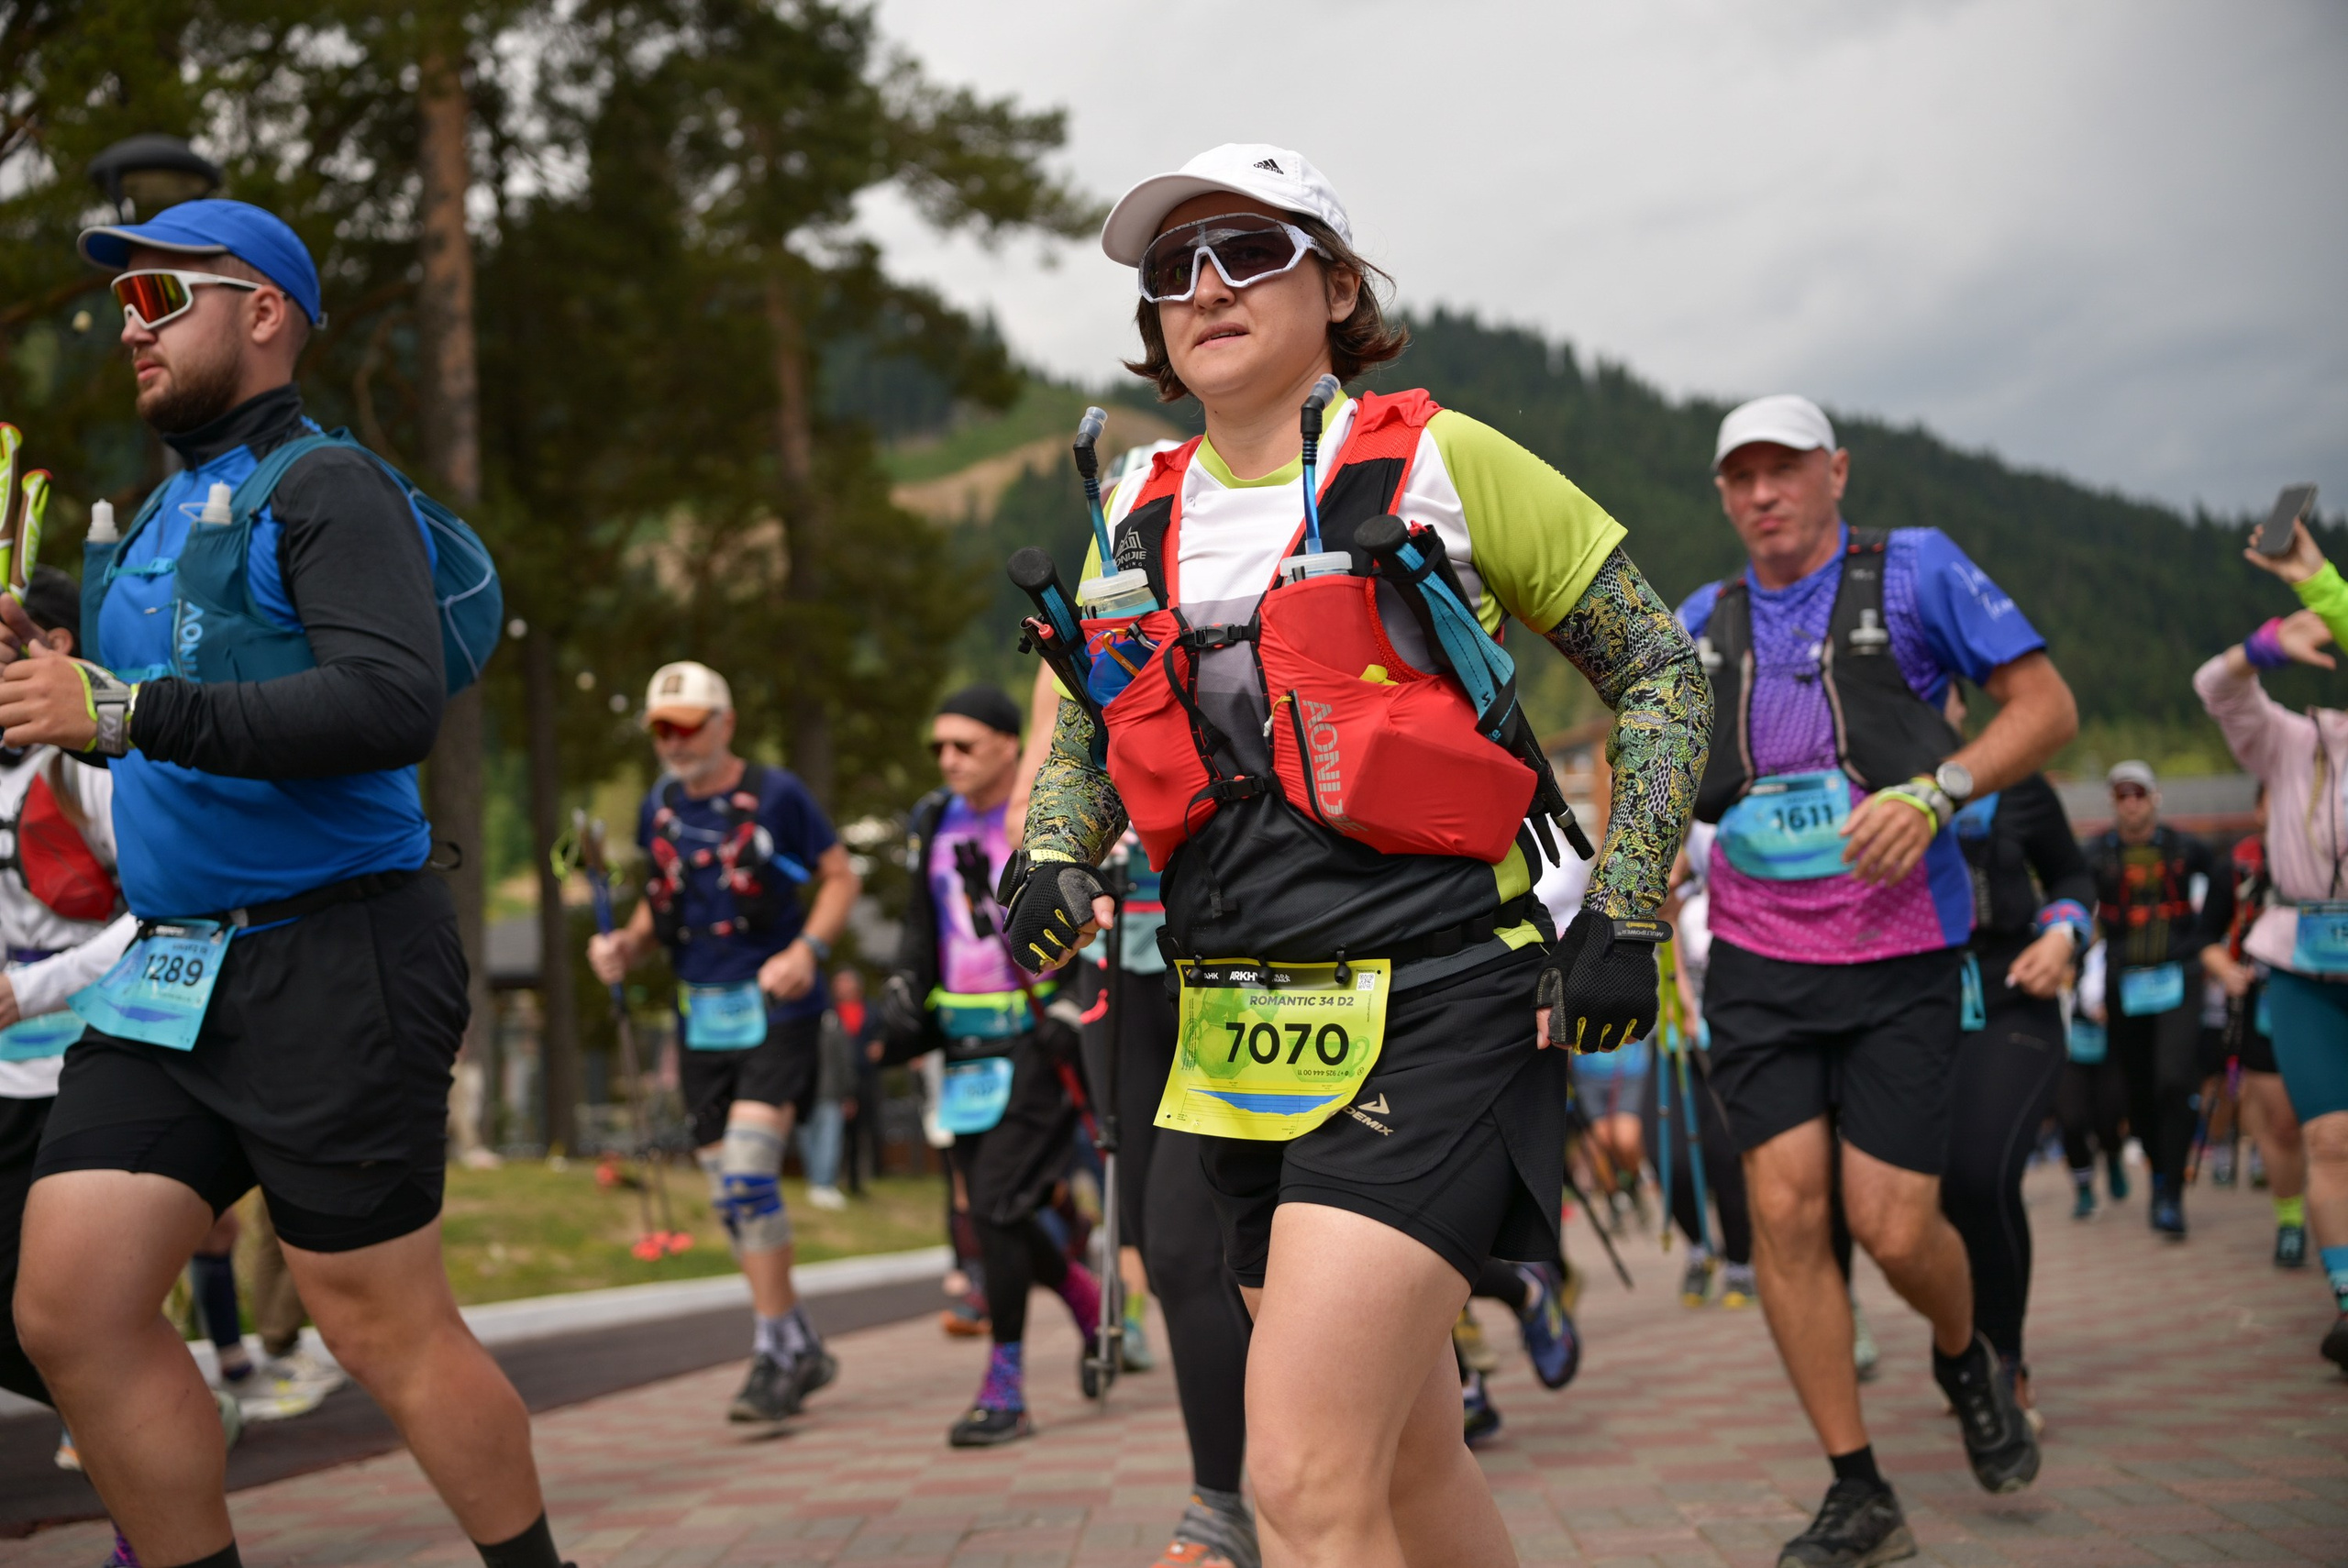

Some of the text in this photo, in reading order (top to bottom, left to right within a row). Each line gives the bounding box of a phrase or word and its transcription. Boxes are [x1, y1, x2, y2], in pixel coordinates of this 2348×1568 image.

[1253, 163, 1284, 174] adidas
[1116, 551, 1146, 567] ONIJIE
[1774, 804, 1833, 832] 1611
[141, 955, 204, 987] 1289
[1249, 995, 1354, 1007] ROMANTIC 34 D2
[1225, 1021, 1349, 1066] 7070
[1343, 1104, 1394, 1136] DEMIX
